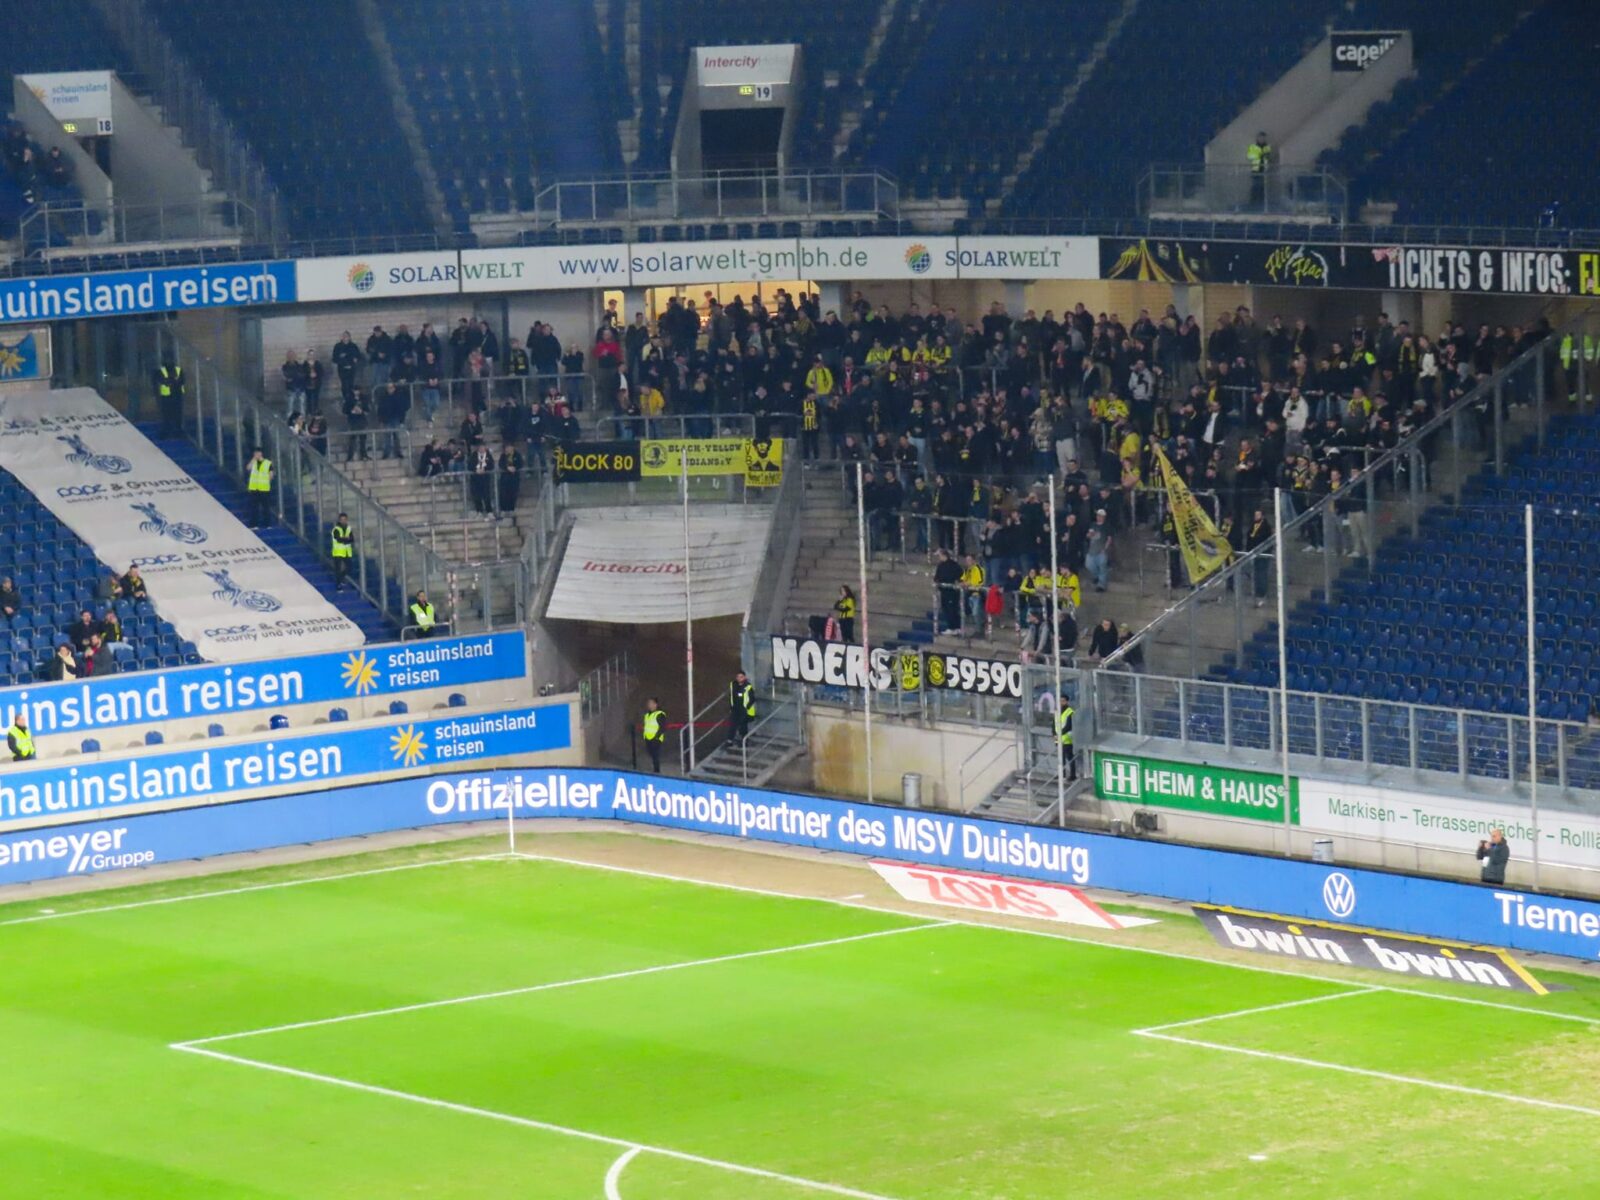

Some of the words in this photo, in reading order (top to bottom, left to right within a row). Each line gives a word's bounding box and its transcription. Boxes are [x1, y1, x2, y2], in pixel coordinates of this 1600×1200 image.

[704, 56, 758, 69] Intercity
[756, 87, 771, 98] 19
[98, 120, 112, 132] 18
[389, 261, 525, 284] SOLARWELT
[945, 250, 1061, 267] SOLARWELT
[1388, 247, 1471, 290] TICKETS
[1478, 251, 1494, 291] &
[0, 272, 154, 319] uinsland
[163, 269, 278, 307] reisen
[613, 455, 634, 471] 80
[110, 482, 124, 492] &
[185, 551, 200, 561] &
[201, 546, 268, 559] Grunau
[582, 561, 686, 575] Intercity
[261, 629, 284, 638] und
[287, 627, 305, 637] vip
[307, 622, 351, 633] services
[388, 639, 493, 668] schauinsland
[772, 637, 892, 690] MOERS
[181, 668, 304, 713] reisen
[389, 667, 440, 687] reisen
[946, 656, 1022, 697] 59590
[435, 711, 536, 740] schauinsland
[435, 739, 484, 758] reisen
[224, 743, 342, 787] reisen
[1144, 768, 1195, 798] HEIM
[1200, 776, 1216, 801] &
[1328, 798, 1396, 823] Markisen
[426, 774, 604, 815] Offizieller
[611, 777, 832, 839] Automobilpartner
[838, 809, 886, 848] des
[893, 815, 954, 855] MSV
[962, 824, 1090, 884] Duisburg
[91, 850, 155, 869] Gruppe
[907, 871, 1059, 918] ZOXS
[1493, 892, 1600, 938] Tieme
[1216, 914, 1353, 964] bwin
[1362, 937, 1512, 988] bwin
